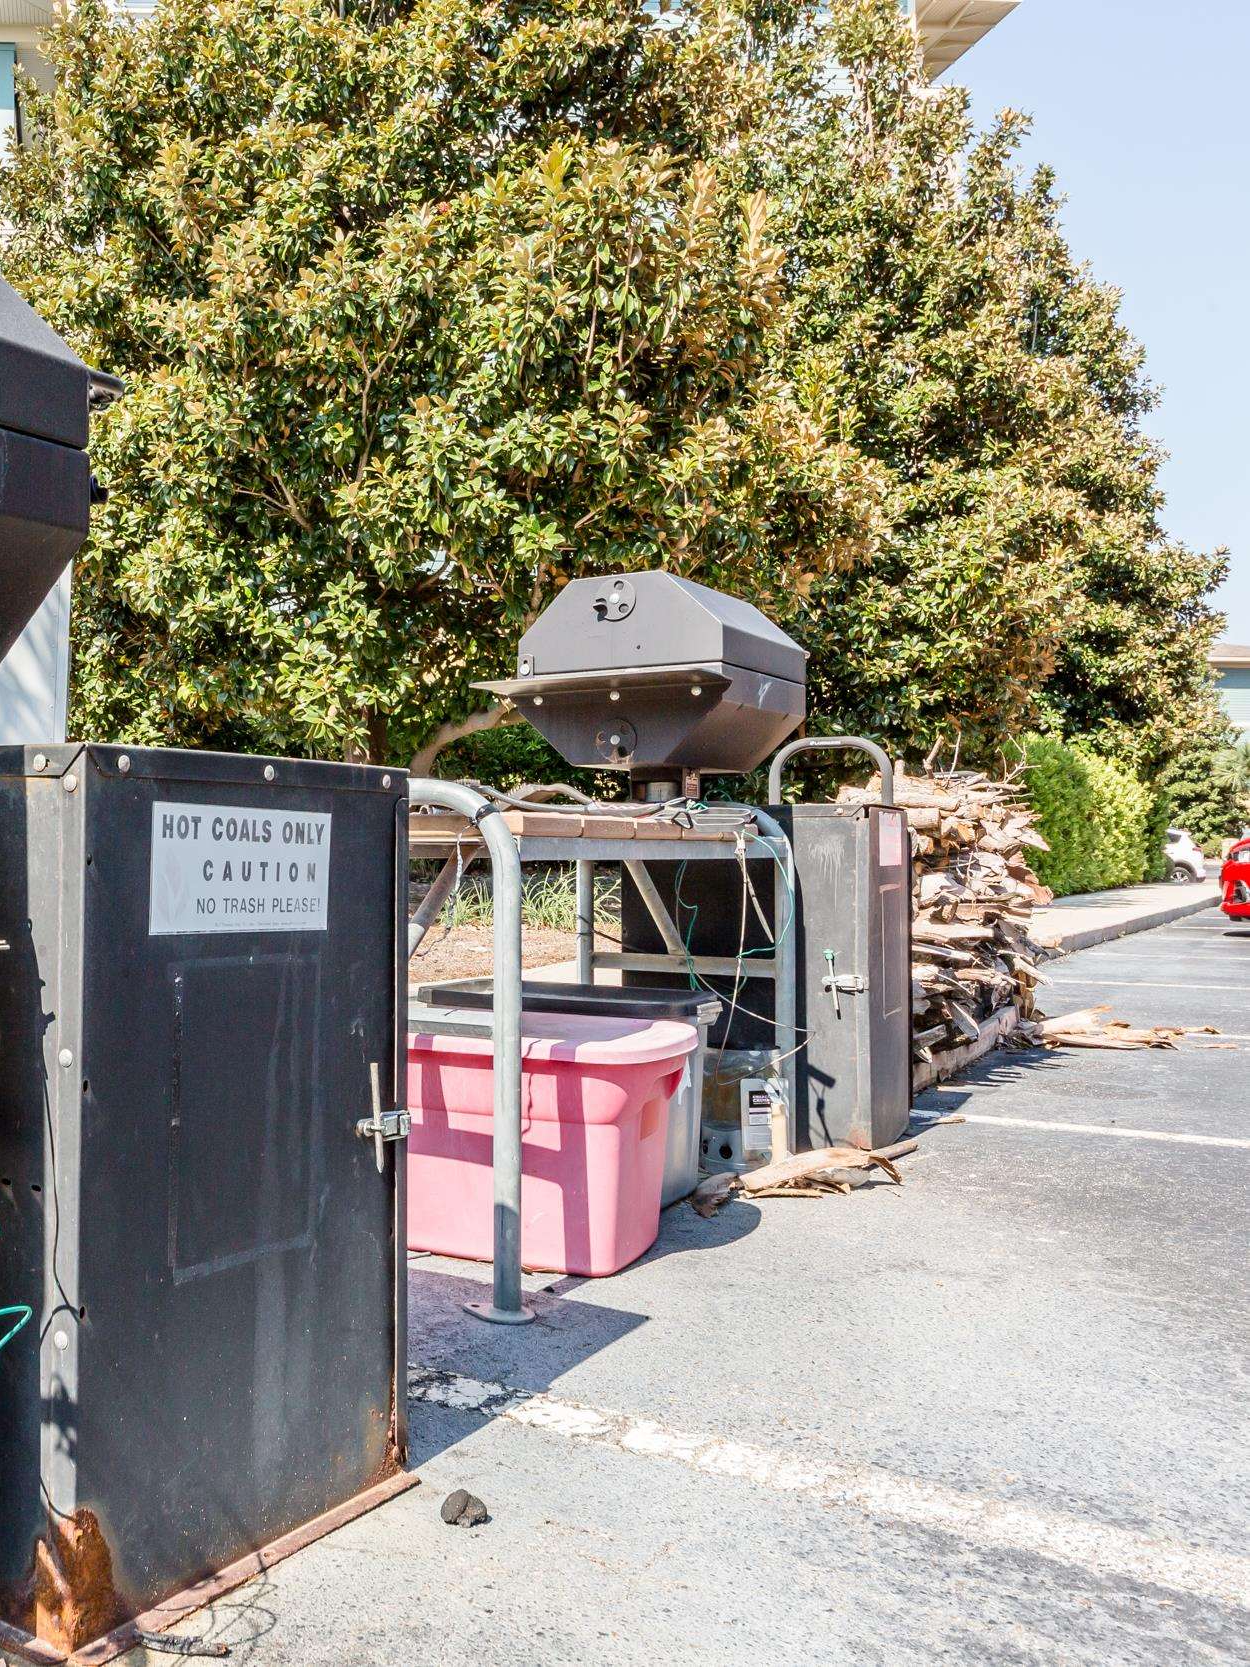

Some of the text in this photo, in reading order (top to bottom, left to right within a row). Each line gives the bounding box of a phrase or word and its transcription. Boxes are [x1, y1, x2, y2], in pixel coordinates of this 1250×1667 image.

[162, 814, 325, 846] HOT COALS ONLY
[203, 859, 316, 882] CAUTION
[196, 897, 321, 914] NO TRASH PLEASE!
